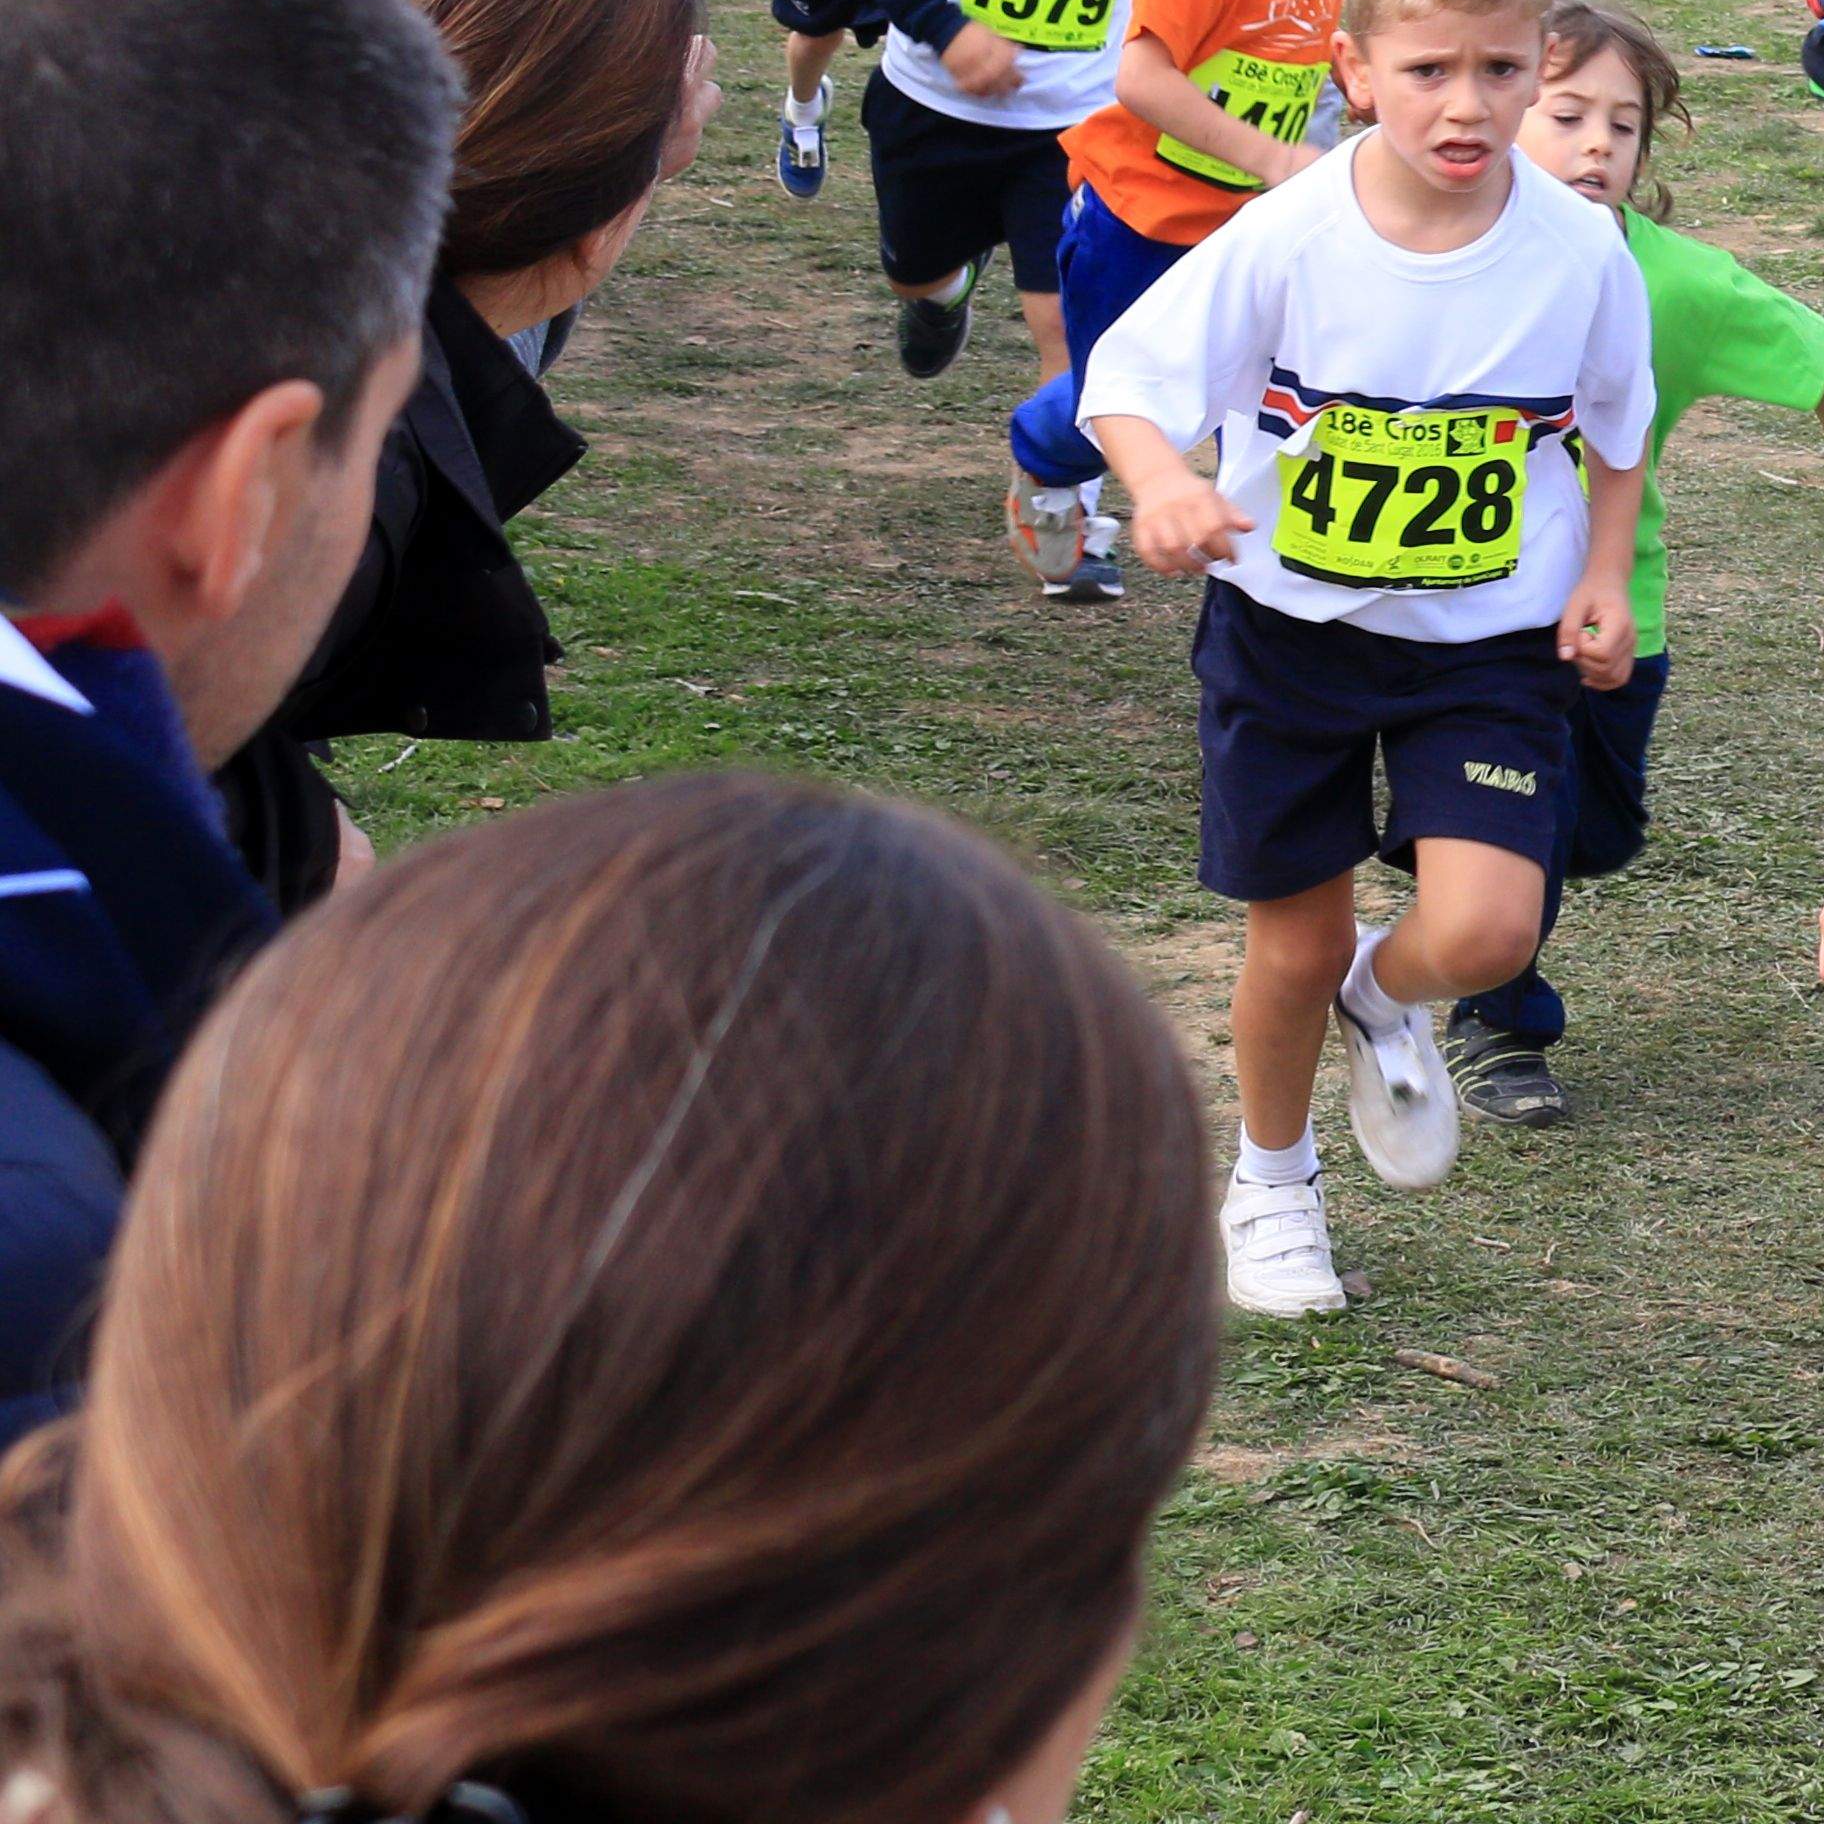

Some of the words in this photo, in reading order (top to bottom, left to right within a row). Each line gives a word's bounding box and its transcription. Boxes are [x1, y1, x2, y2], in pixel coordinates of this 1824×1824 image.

[1231, 57, 1268, 82] 18è
[1326, 410, 1373, 437] 18è
[1385, 417, 1441, 441] Cros
[1291, 451, 1517, 548] 4728
